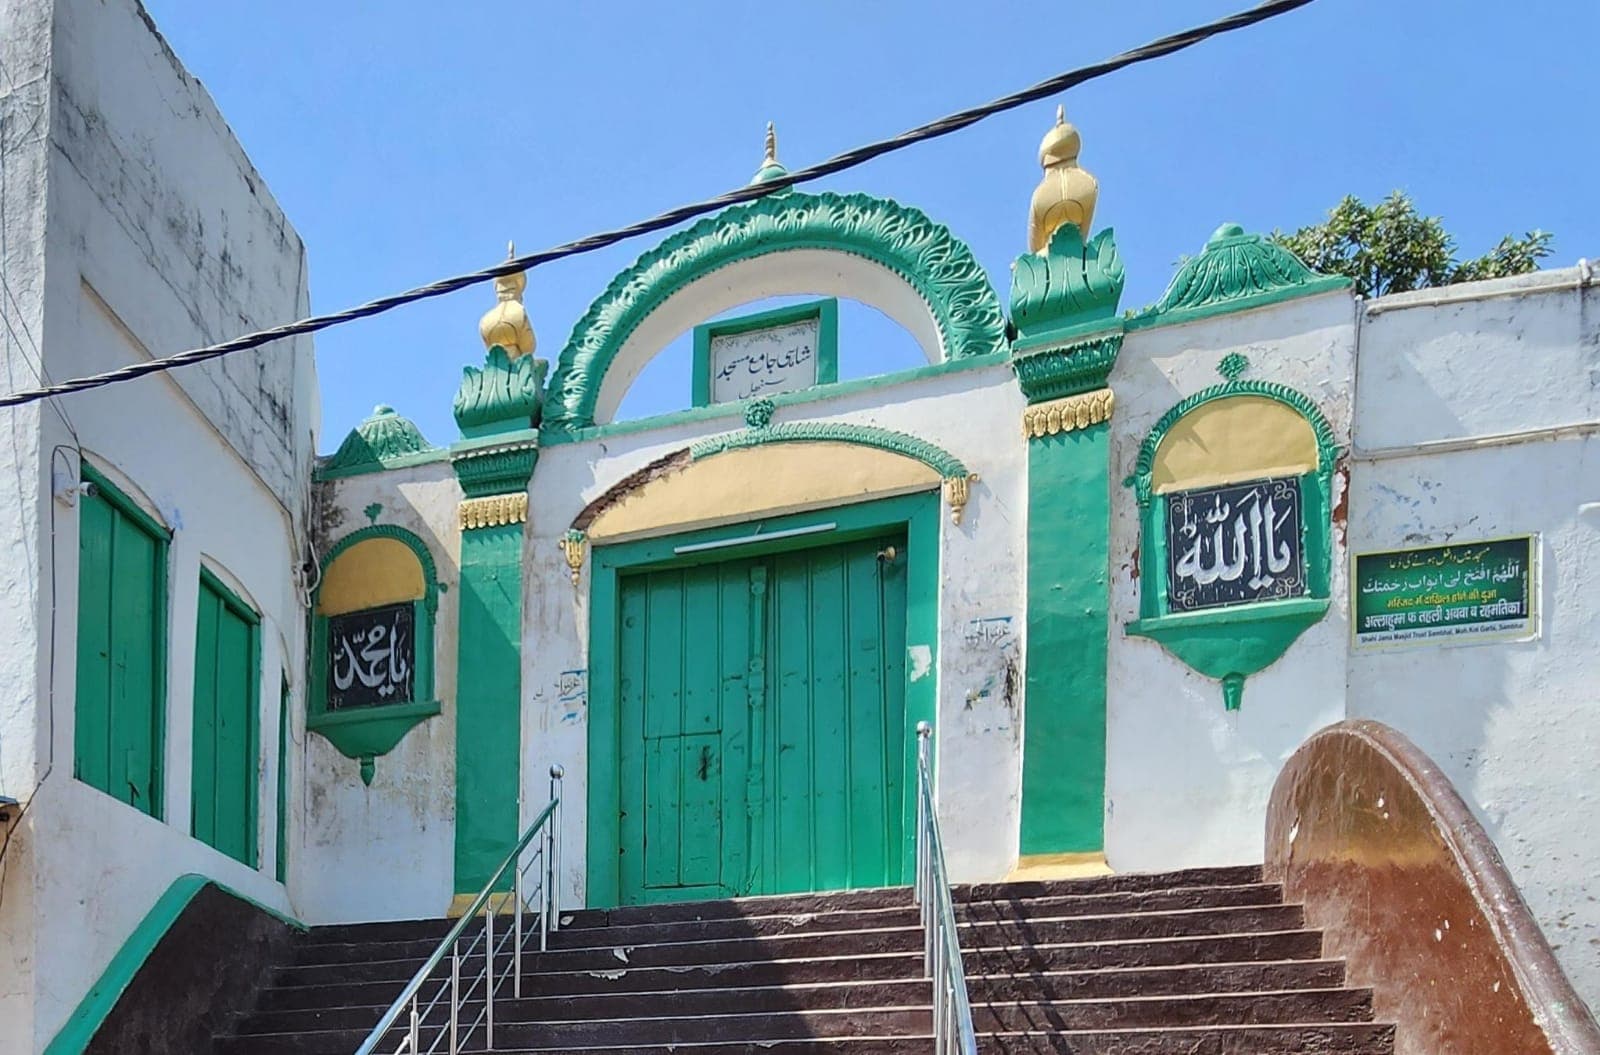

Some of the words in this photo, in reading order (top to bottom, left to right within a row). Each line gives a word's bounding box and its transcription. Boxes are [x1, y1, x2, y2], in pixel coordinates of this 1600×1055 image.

[716, 355, 750, 381] مسجد
[748, 352, 777, 374] جامع
[1407, 612, 1417, 623] फ
